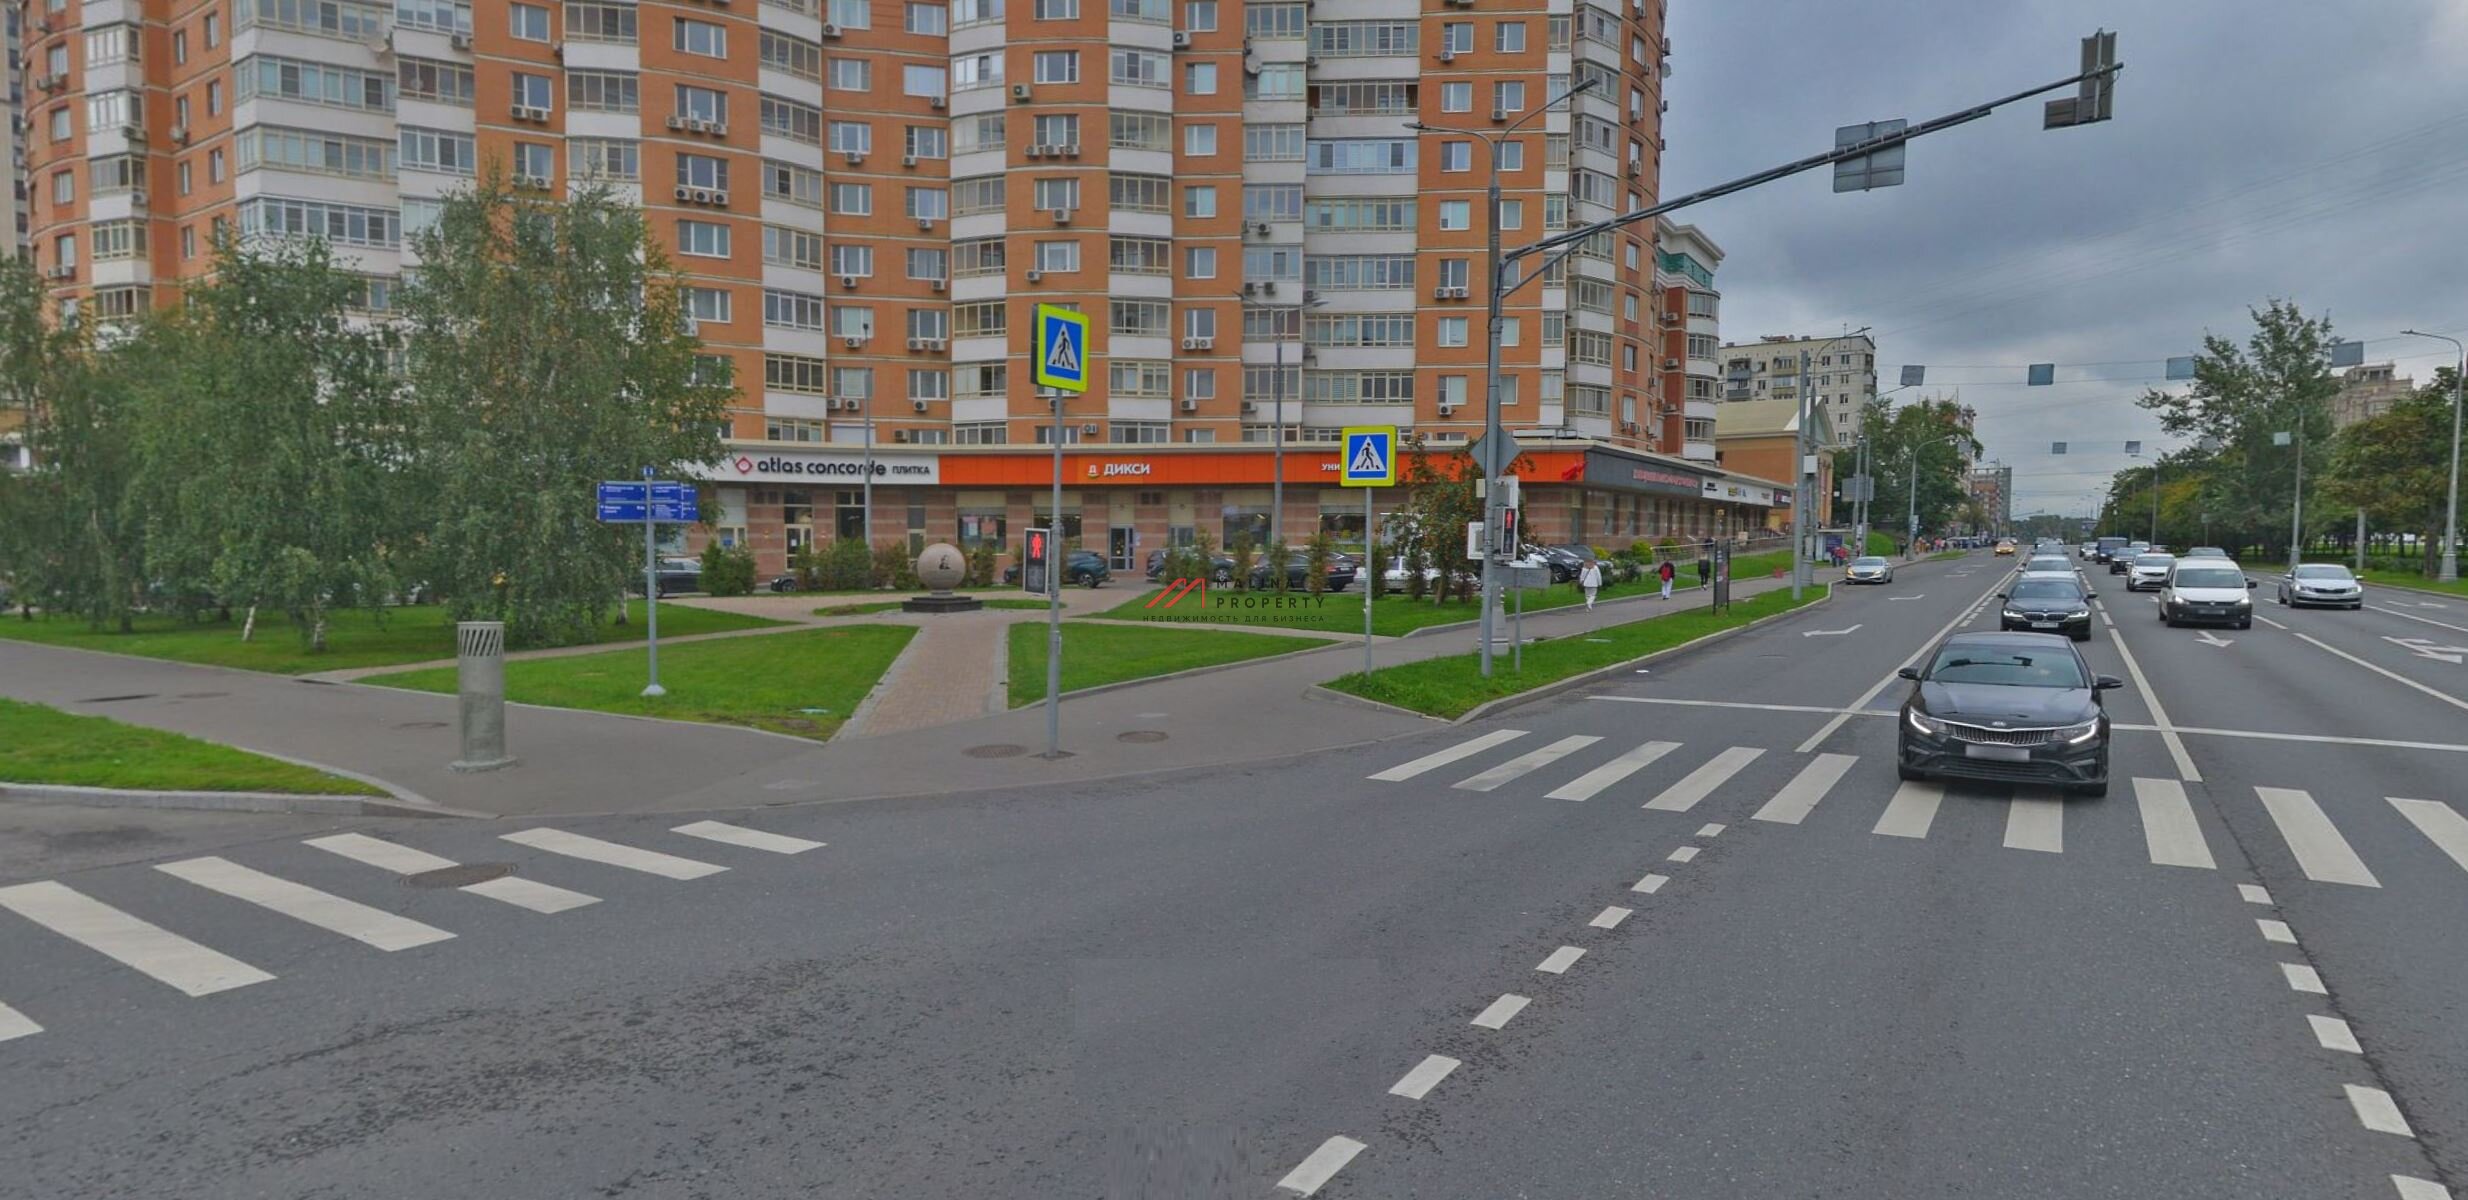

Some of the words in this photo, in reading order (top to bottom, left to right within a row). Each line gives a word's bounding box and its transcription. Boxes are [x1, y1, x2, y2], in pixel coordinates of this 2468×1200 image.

[757, 456, 803, 473] atlas
[806, 460, 887, 476] concorde
[892, 465, 930, 475] ПЛИТКА
[1103, 463, 1150, 476] ДИКСИ
[1321, 463, 1341, 471] УНИ
